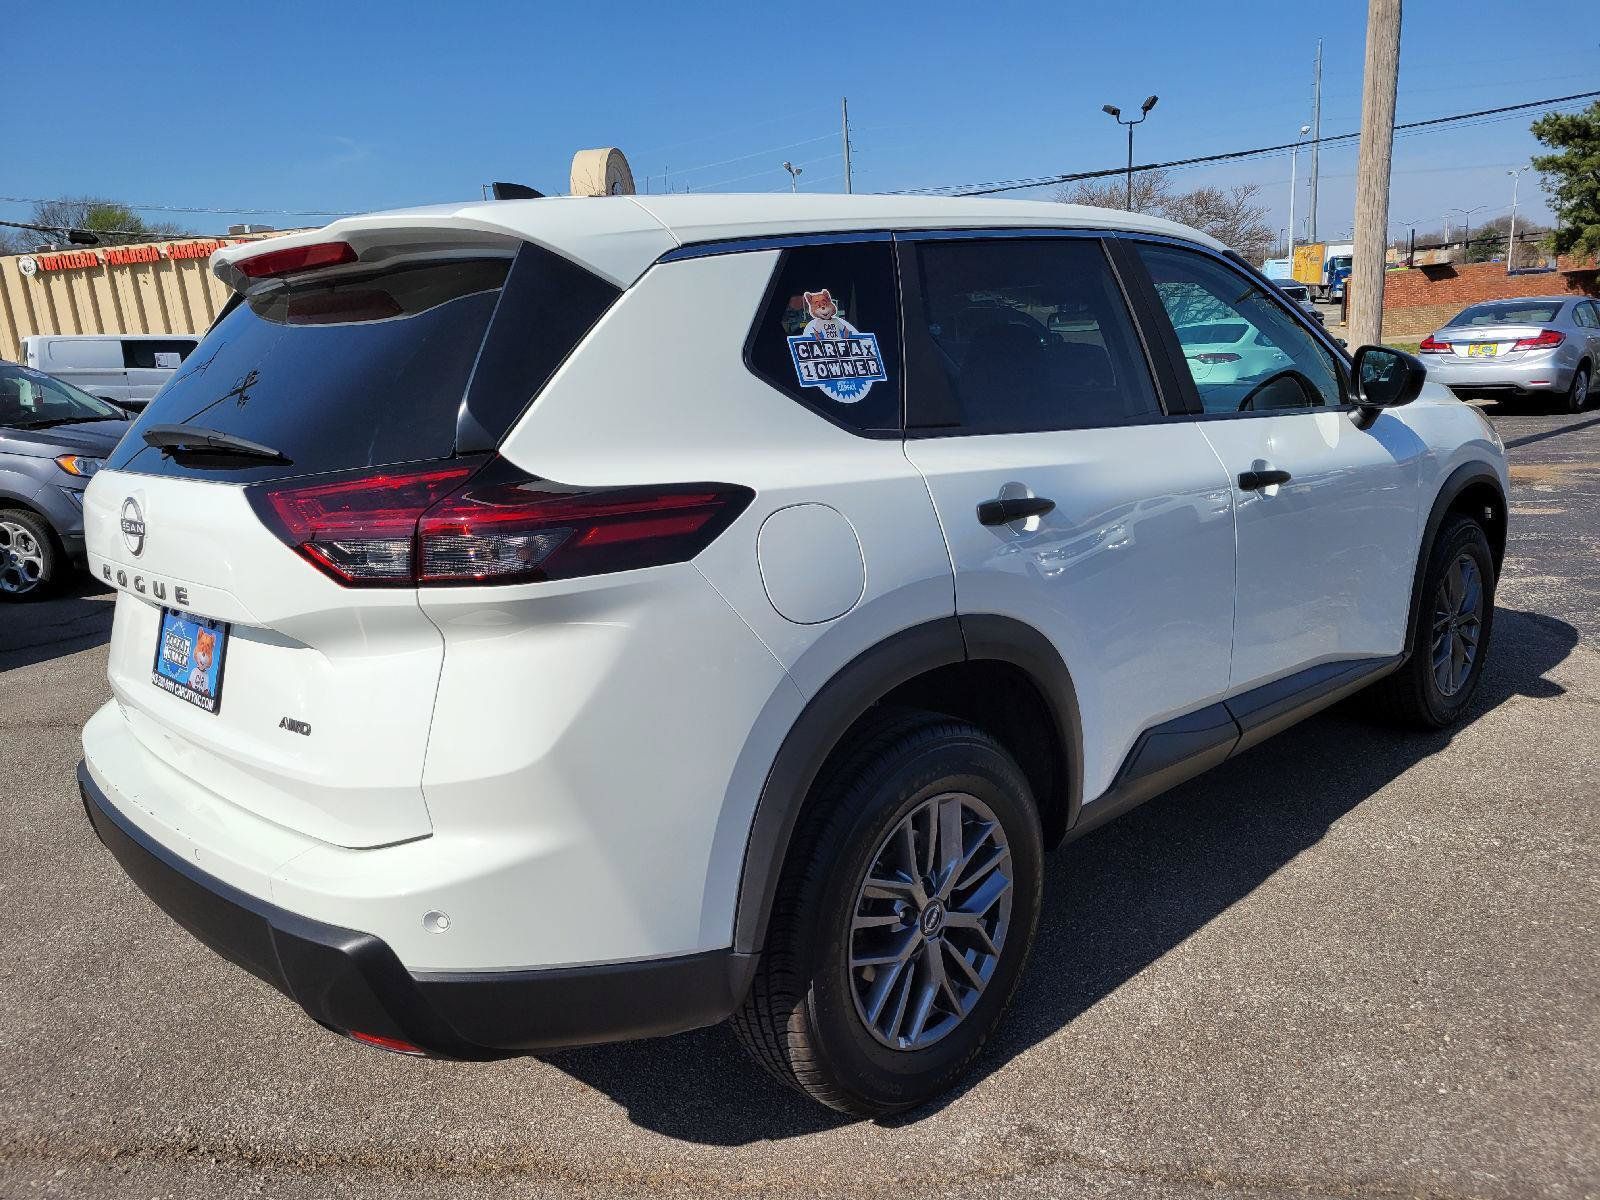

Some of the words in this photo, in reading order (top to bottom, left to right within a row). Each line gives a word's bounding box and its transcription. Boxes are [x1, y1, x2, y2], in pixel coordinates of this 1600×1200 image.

[798, 342, 878, 358] CARFAX
[817, 360, 878, 377] OWNER
[102, 563, 190, 606] ROGUE
[278, 716, 312, 737] AWD
